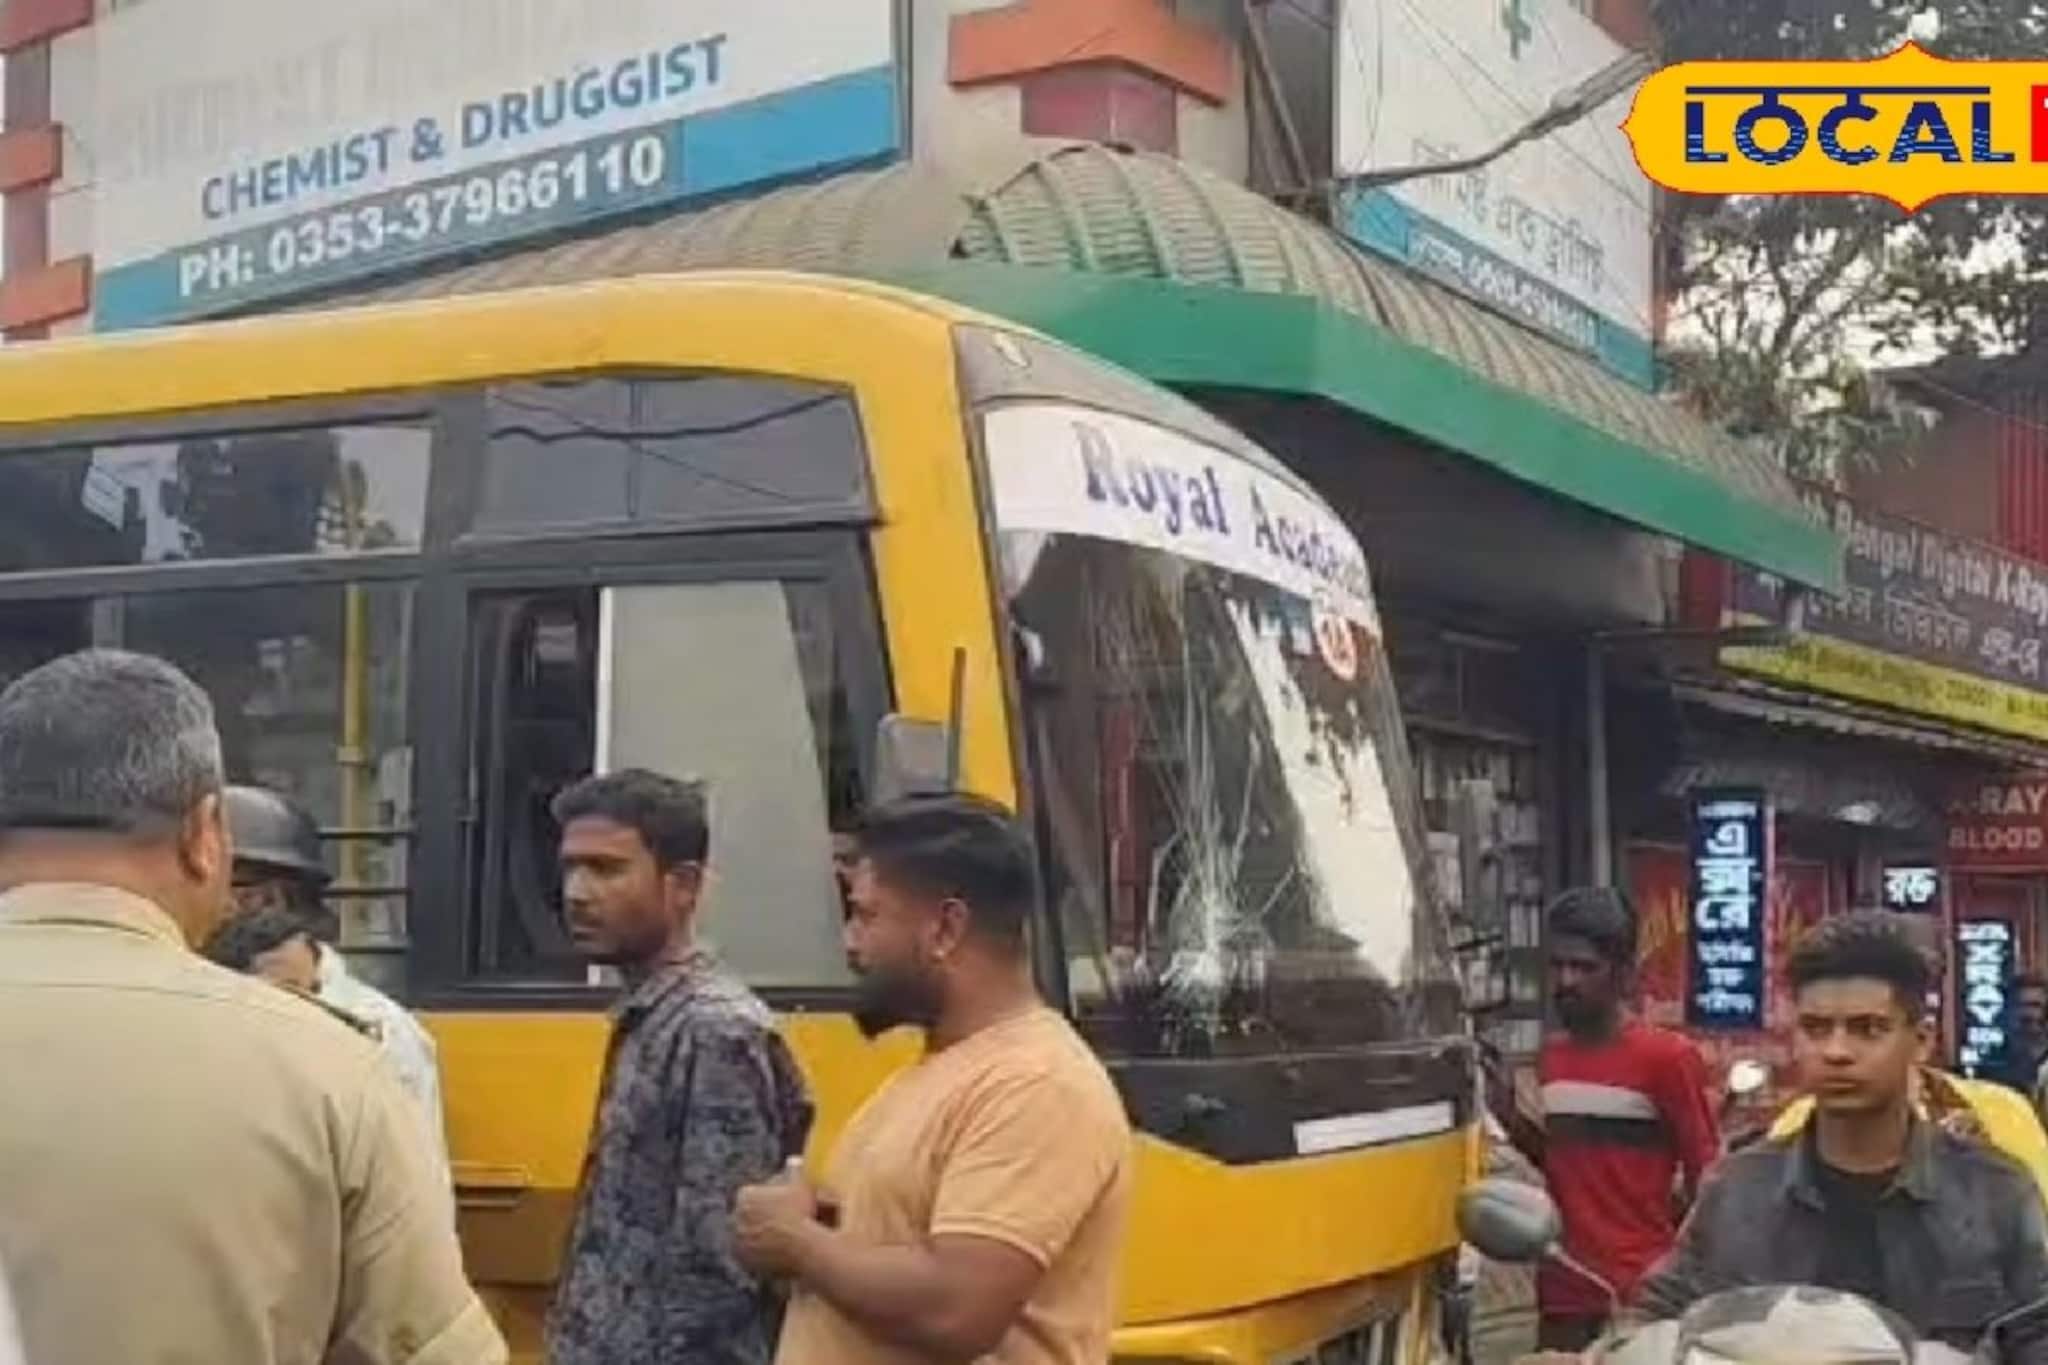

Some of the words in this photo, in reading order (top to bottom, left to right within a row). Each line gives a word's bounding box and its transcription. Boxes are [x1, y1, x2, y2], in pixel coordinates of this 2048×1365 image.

[202, 126, 398, 220] CHEMIST
[411, 117, 444, 162] &
[460, 33, 727, 149] DRUGGIST
[178, 246, 255, 297] PH:
[267, 134, 666, 275] 0353-37966110
[1072, 420, 1231, 536] Royal
[1949, 826, 2043, 850] BLOOD
